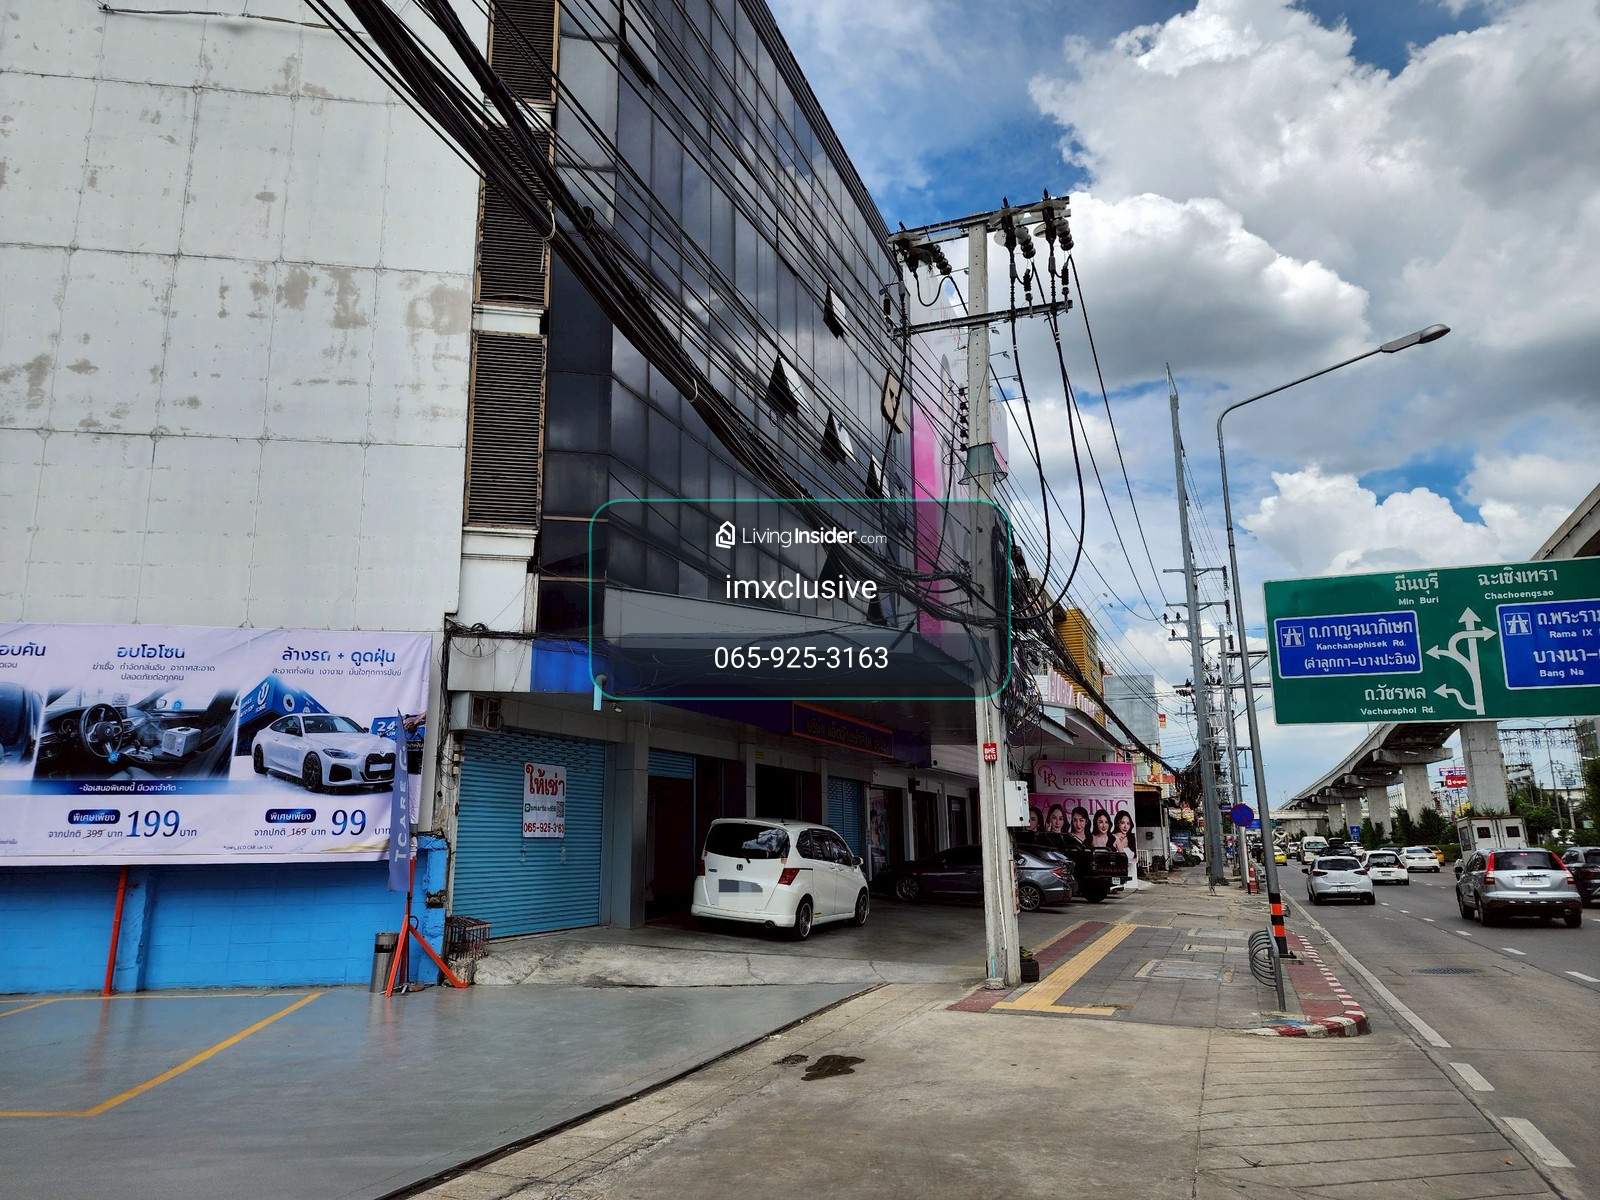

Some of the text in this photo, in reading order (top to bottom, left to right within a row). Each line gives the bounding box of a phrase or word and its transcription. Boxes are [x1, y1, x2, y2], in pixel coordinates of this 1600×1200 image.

[1478, 566, 1558, 586] ฉะเชิงเทรา
[1395, 572, 1439, 594] มีนบุรี
[1484, 589, 1554, 600] Chachoengsao
[1398, 596, 1439, 606] Min Buri
[1309, 618, 1413, 641] ถ.กาญจนาภิเษก
[1549, 629, 1593, 638] Rama IX
[1316, 639, 1407, 650] Kanchanaphisek Rd.
[117, 644, 185, 658] อบโอโซน
[282, 646, 331, 661] ล้างรถ
[351, 648, 396, 667] ดูดฝุ่น
[170, 664, 216, 672] อากาศสะอาด
[1540, 668, 1584, 678] Bang Na
[1364, 684, 1426, 701] ถ.วัชรพล
[1360, 706, 1417, 715] Vacharaphol
[526, 764, 565, 796] ให้เช่า
[1063, 777, 1131, 787] PURRA CLINIC
[137, 783, 177, 792] มีเวลาจำกัด
[73, 809, 197, 838] พิเศษเพียง 199 บาท
[270, 812, 312, 821] พิเศษเพียง
[331, 809, 366, 836] 99
[48, 829, 123, 838] จากปกติ 399 บาท
[254, 827, 326, 836] จากปกติ 169 บาท
